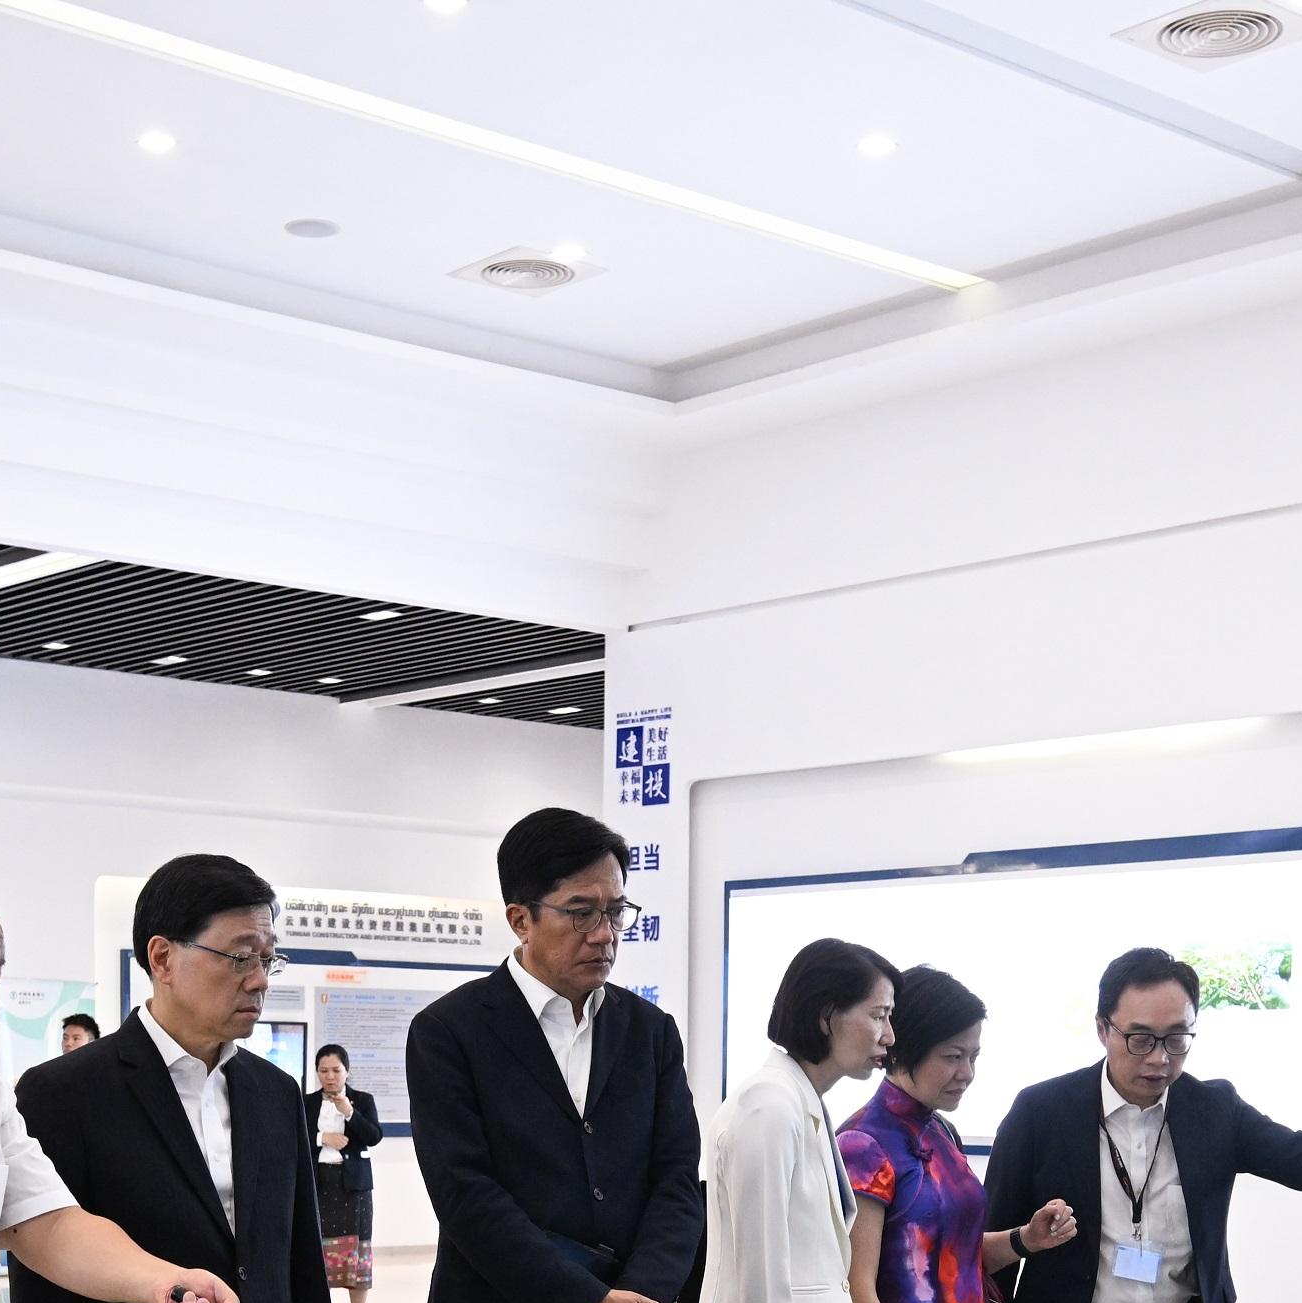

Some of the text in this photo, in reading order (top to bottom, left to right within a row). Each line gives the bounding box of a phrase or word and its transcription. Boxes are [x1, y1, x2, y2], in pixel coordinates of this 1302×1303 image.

[618, 730, 640, 763] 建
[647, 727, 669, 744] 美好
[646, 745, 667, 761] 生活
[644, 768, 667, 799] 投
